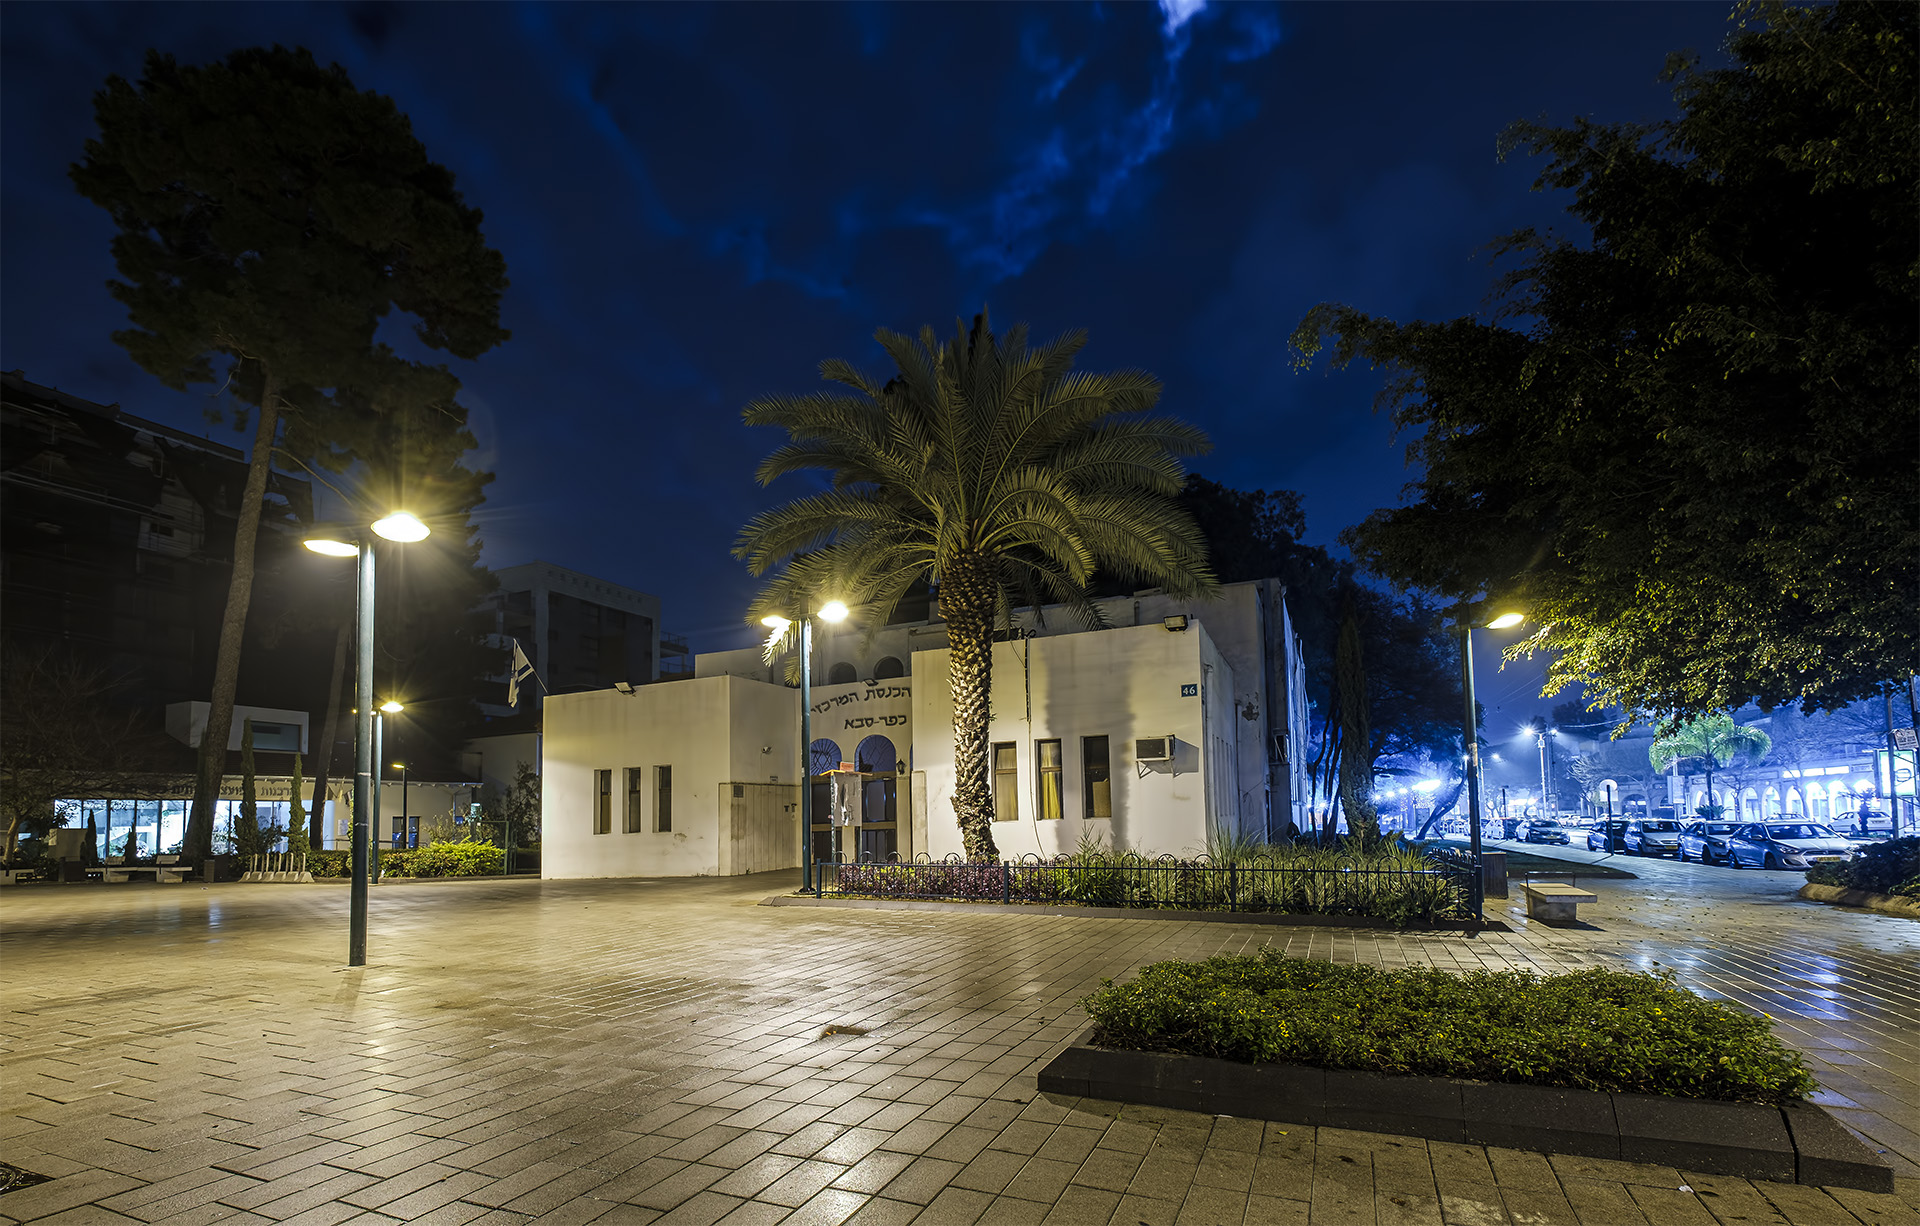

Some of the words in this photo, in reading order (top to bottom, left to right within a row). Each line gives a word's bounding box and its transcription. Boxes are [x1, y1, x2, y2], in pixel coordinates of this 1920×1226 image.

[864, 686, 911, 701] הכנסת
[1182, 686, 1196, 695] 46
[810, 692, 860, 714] המרכזי
[844, 714, 907, 730] כפר-סבא
[260, 786, 292, 797] רבנות
